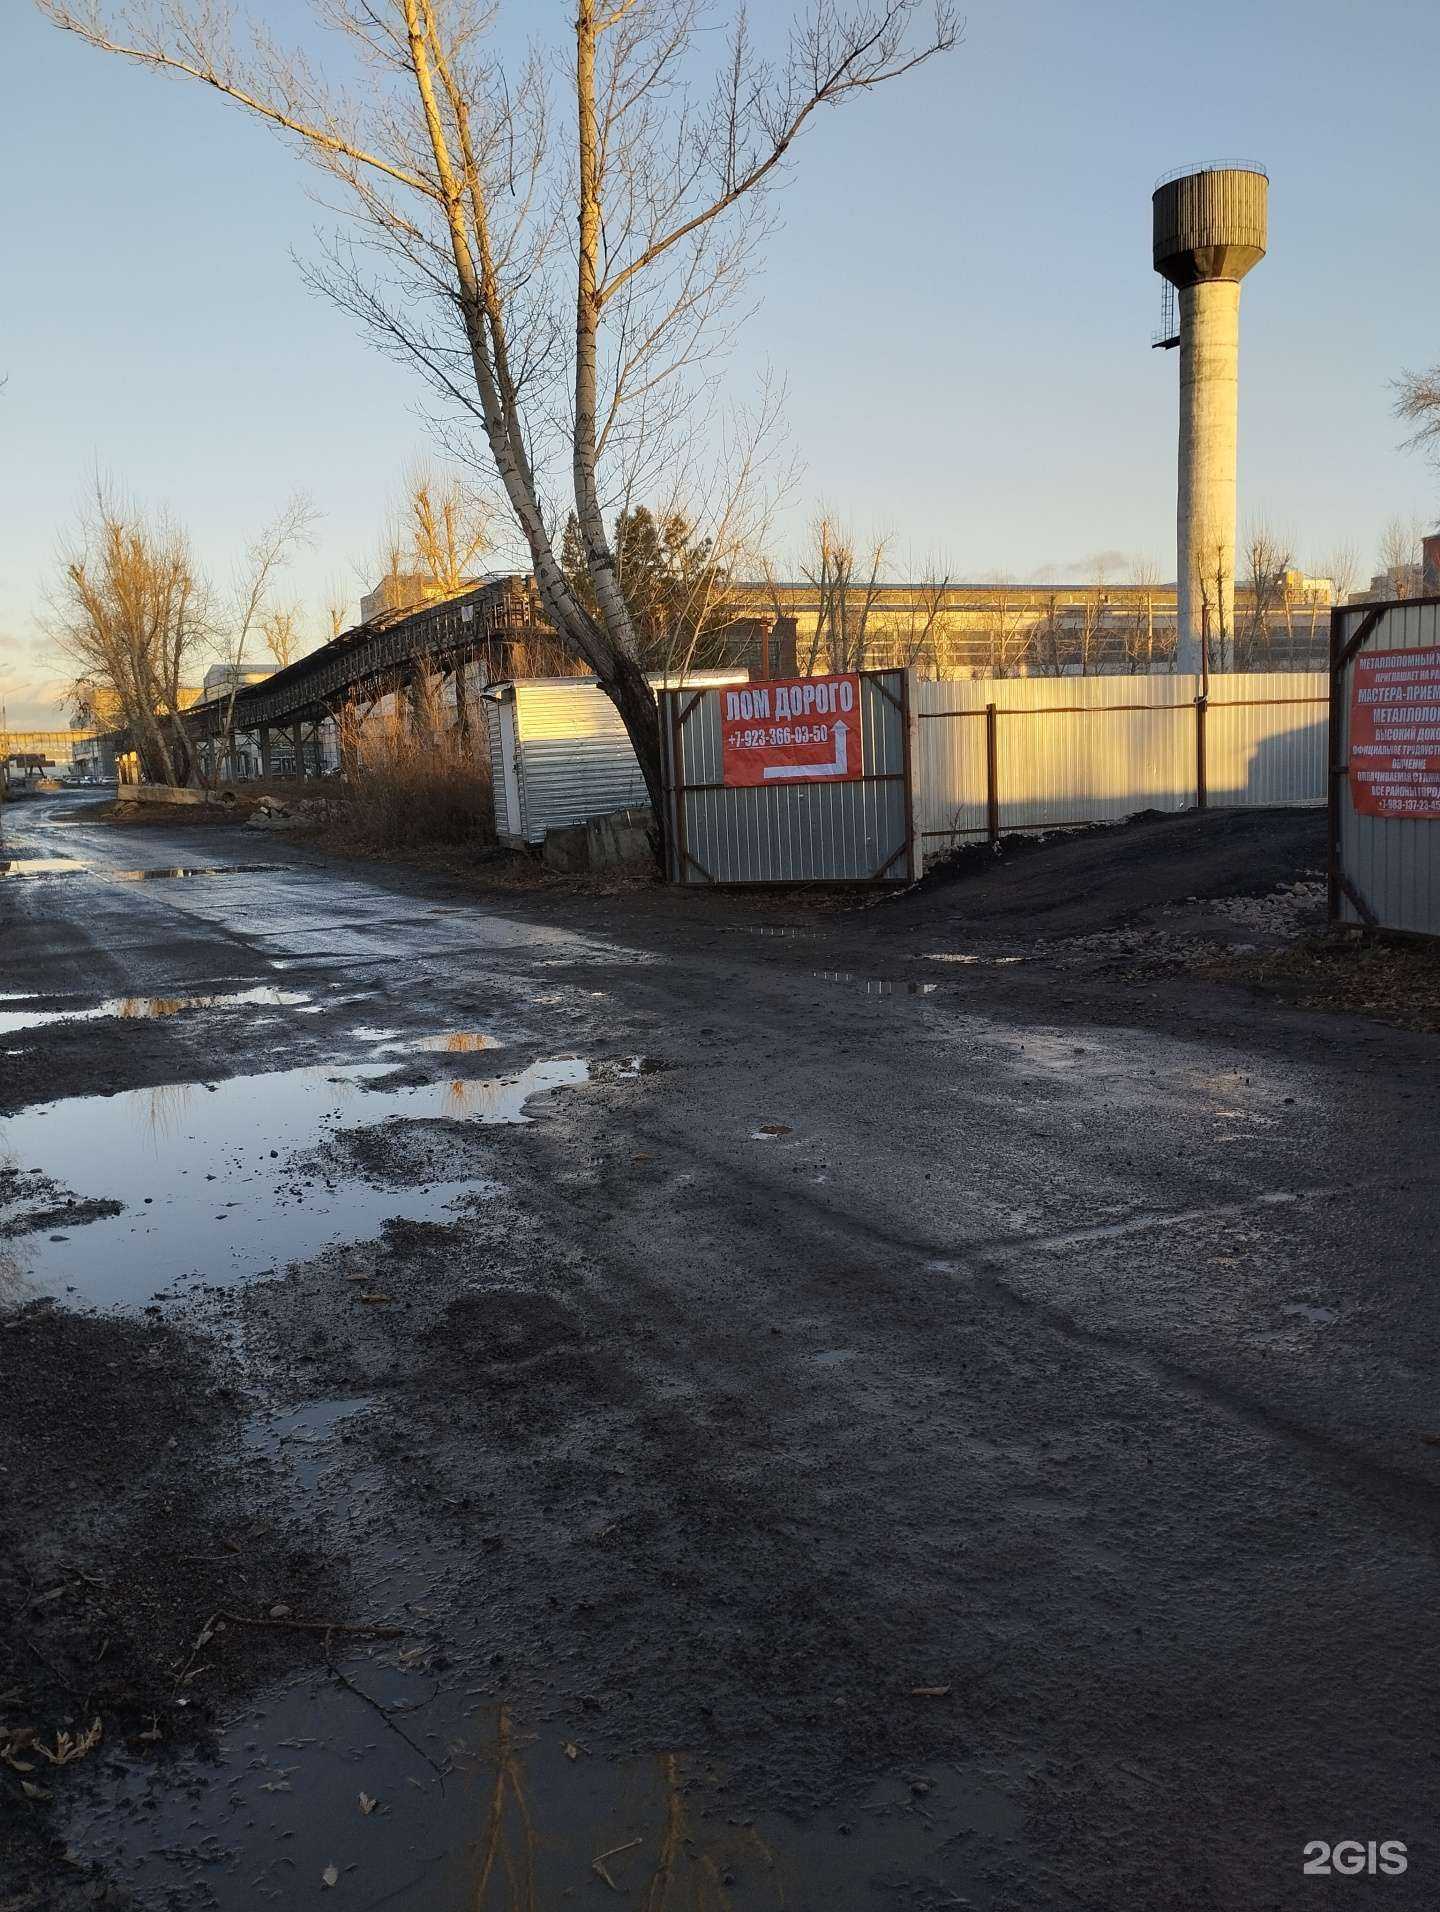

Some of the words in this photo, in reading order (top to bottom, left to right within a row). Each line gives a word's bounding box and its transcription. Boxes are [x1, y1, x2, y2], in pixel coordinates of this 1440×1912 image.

[727, 688, 770, 720] ЛОМ
[775, 681, 853, 721] ДОРОГО
[728, 724, 828, 747] +7-923-366-03-50
[1375, 726, 1416, 741] ВЫСОКИЙ
